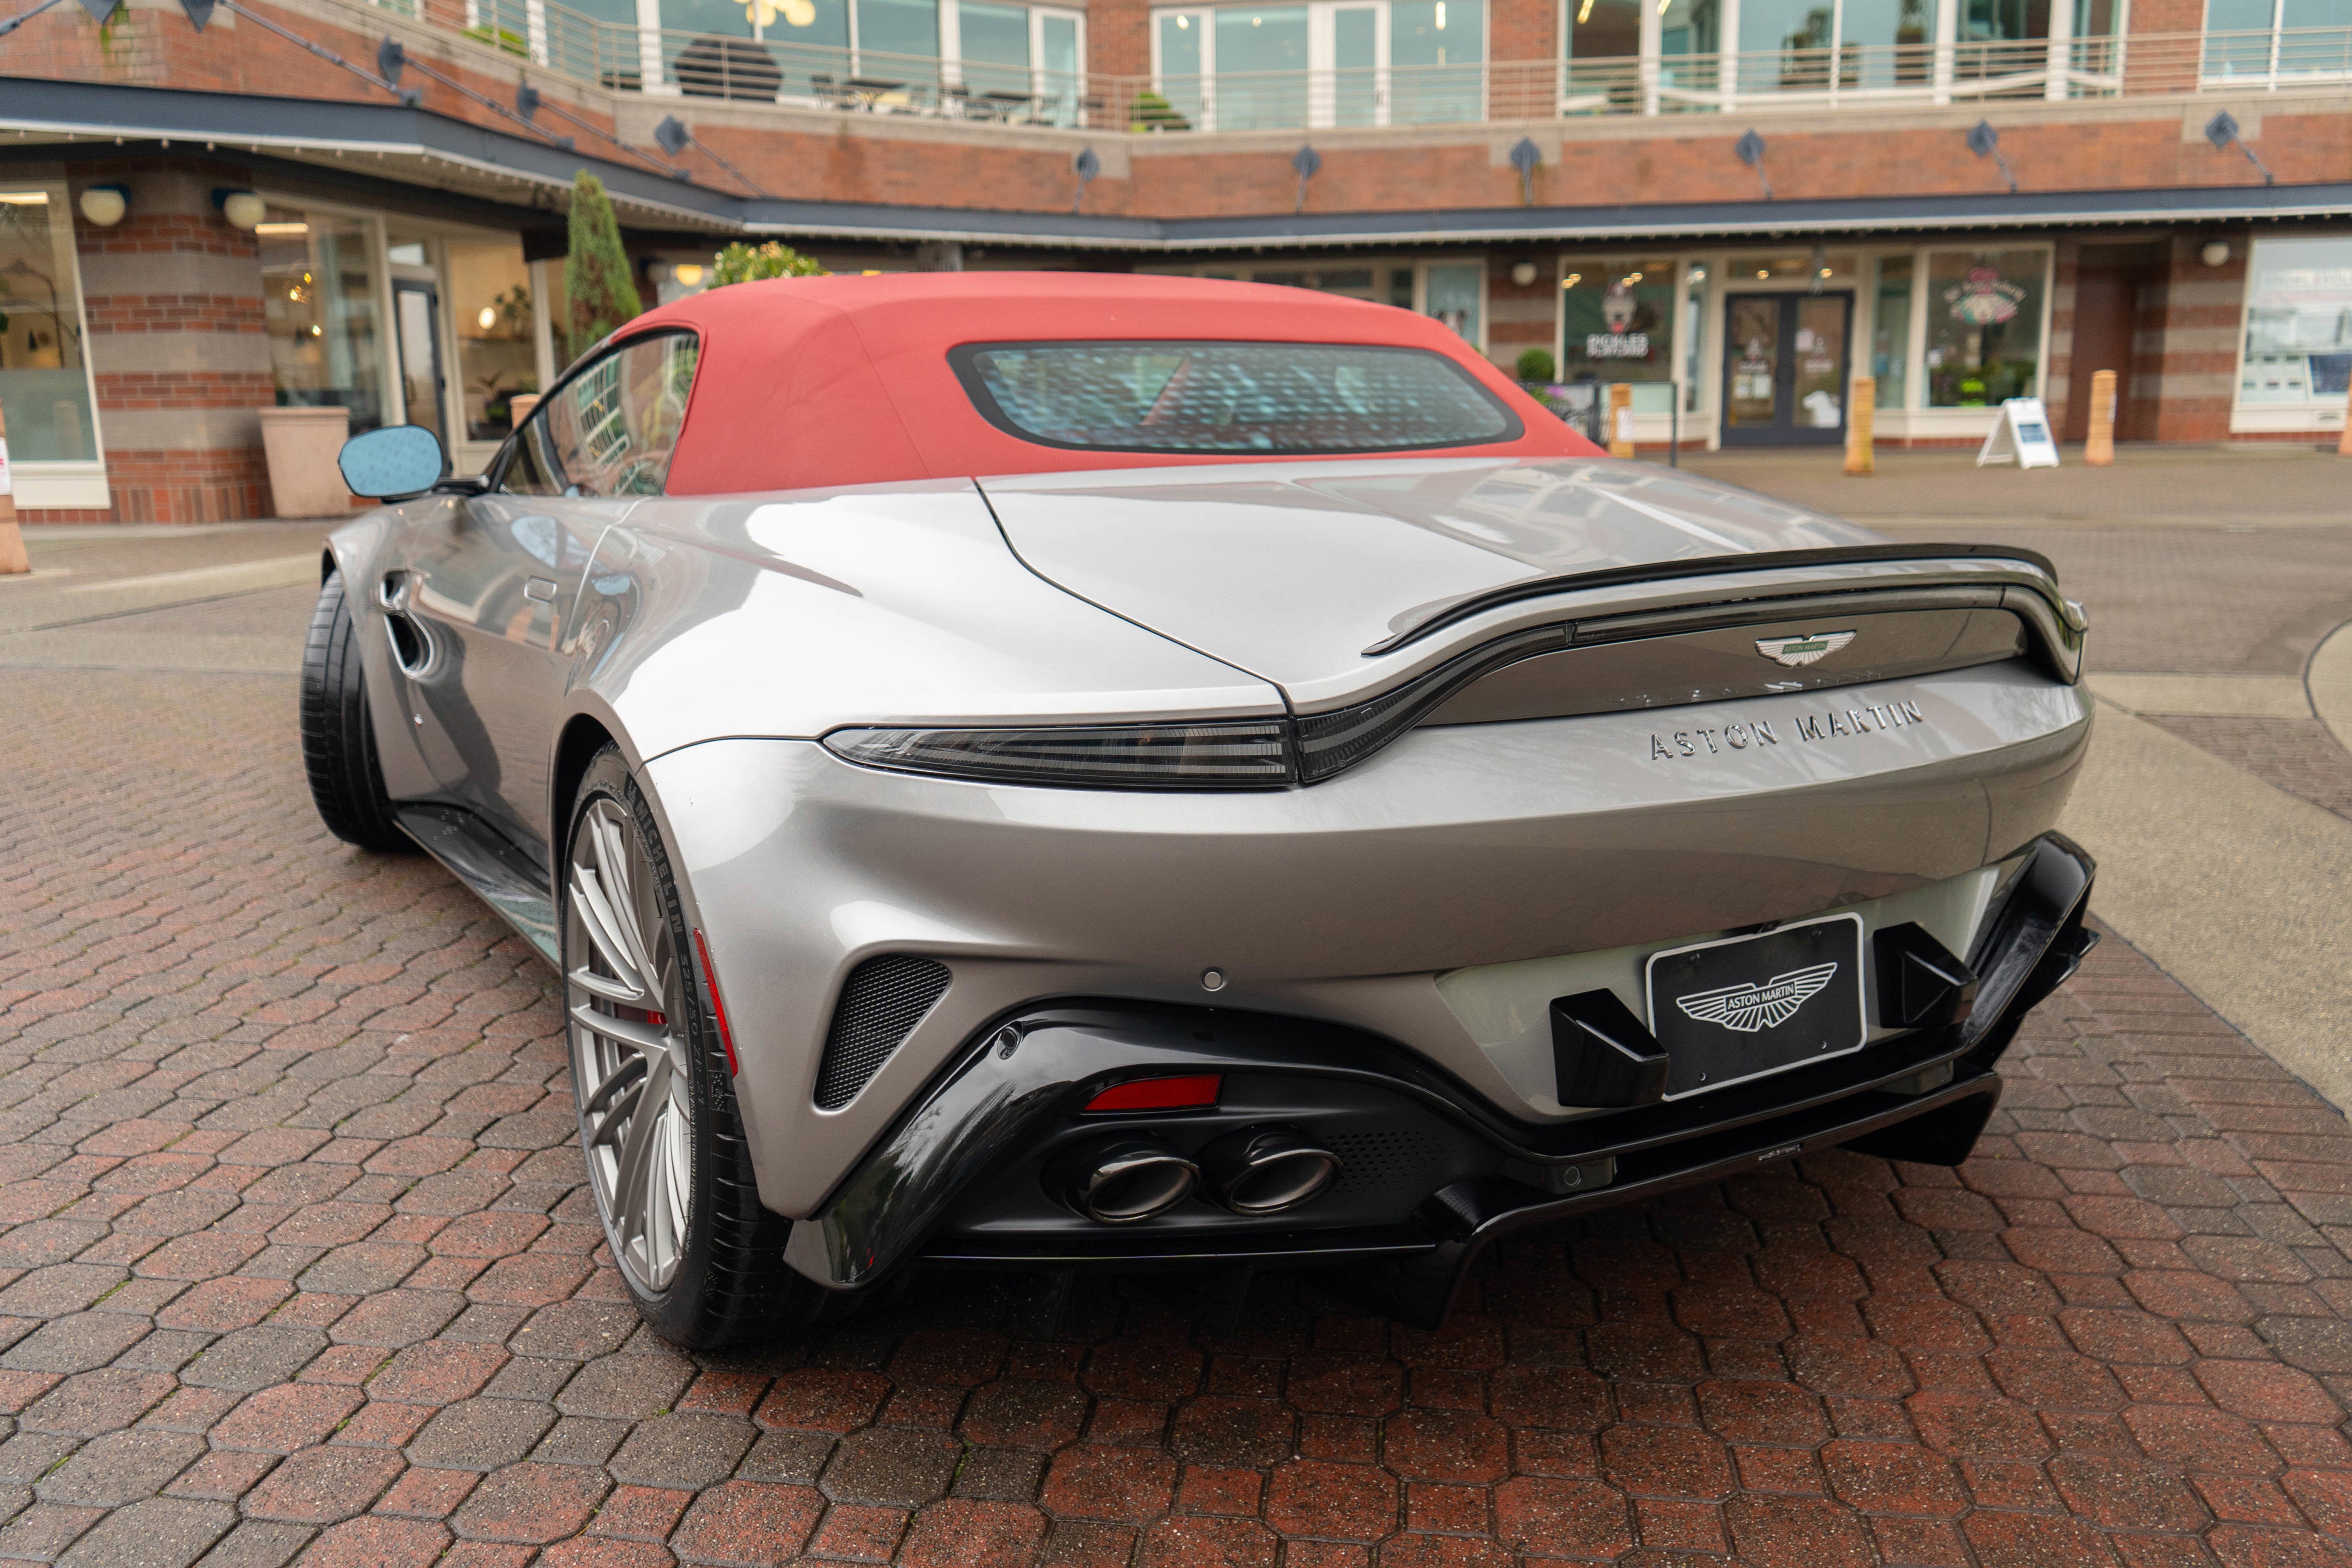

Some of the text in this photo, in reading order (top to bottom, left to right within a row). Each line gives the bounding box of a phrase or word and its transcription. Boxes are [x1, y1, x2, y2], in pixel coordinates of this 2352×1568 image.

[1651, 700, 1923, 760] ASTON MARTIN
[635, 800, 682, 933] MICHELIN
[1728, 984, 1794, 1010] ASTON MARTIN
